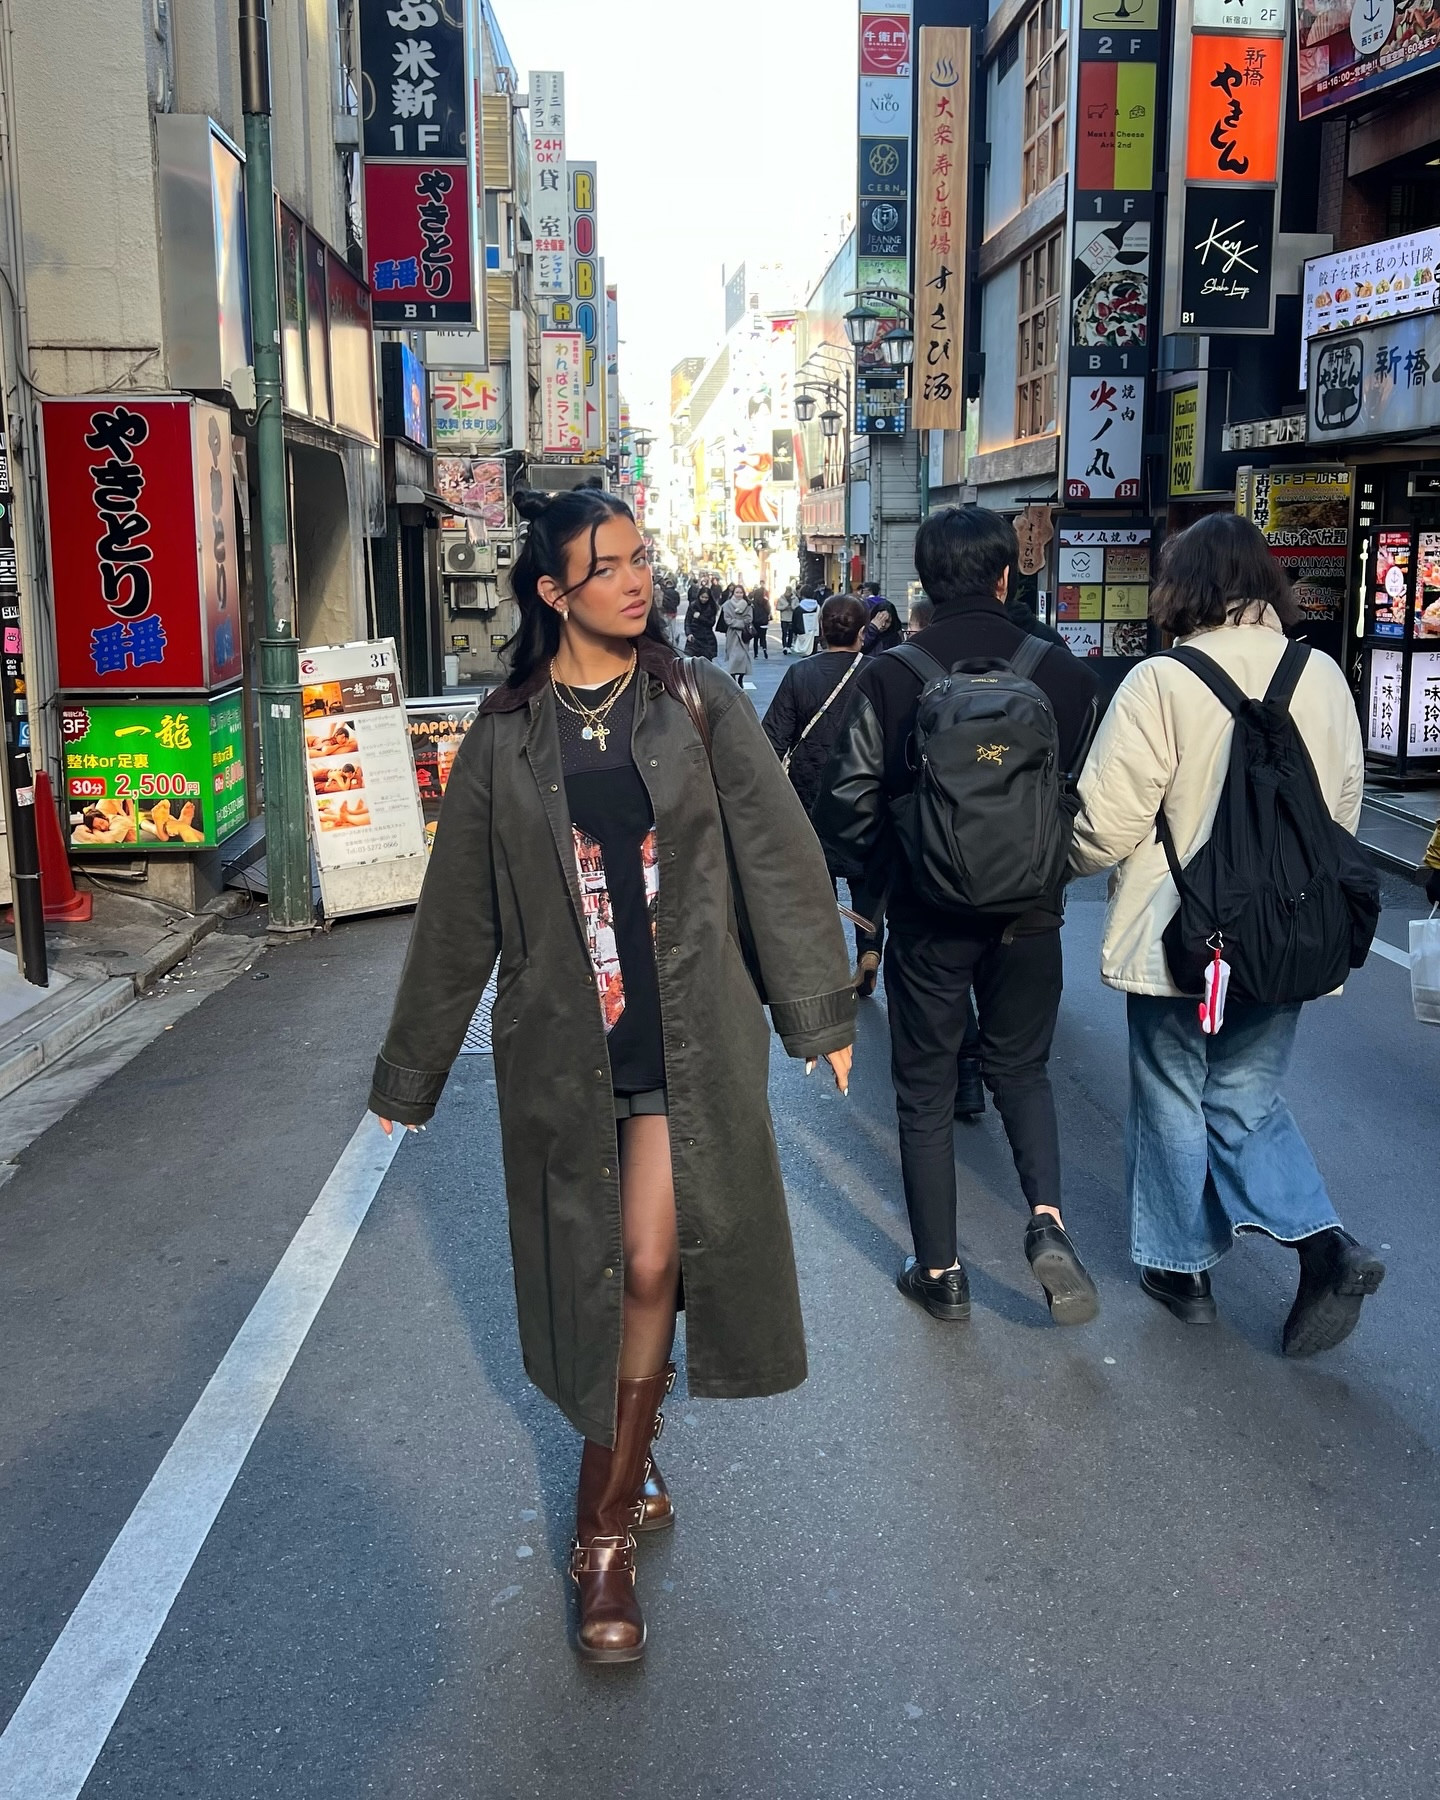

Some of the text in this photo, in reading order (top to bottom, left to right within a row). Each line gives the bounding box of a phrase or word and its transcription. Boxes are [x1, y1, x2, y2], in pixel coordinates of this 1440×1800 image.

[1222, 16, 1251, 24] (新宿店)
[1261, 9, 1277, 20] 2F
[864, 31, 906, 43] 牛衛門
[1243, 47, 1266, 87] 新橋
[870, 96, 900, 112] Nico
[534, 97, 544, 128] テラコ
[1210, 62, 1249, 175] やきとん
[389, 124, 441, 151] 1F
[534, 138, 562, 151] 24H
[537, 153, 561, 164] OK!
[930, 96, 954, 256] 大衆寿し酒場
[867, 184, 900, 192] CERN
[416, 169, 454, 298] やきとり
[867, 234, 902, 244] JEANNE
[1195, 217, 1259, 274] Key
[404, 304, 437, 319] B1
[1182, 313, 1194, 323] B1
[924, 265, 954, 401] すさび湯
[1374, 345, 1430, 389] 新橋
[434, 385, 500, 411] ランド
[863, 402, 900, 417] TOKYO
[1176, 401, 1197, 416] Italian
[1086, 380, 1118, 479] 火ノ丸
[1175, 424, 1194, 441] BOTTLE
[1175, 441, 1192, 457] WINE
[1173, 461, 1191, 486] 1900
[1273, 472, 1350, 485] 5F ゴールド館
[1069, 483, 1138, 496] 6F B1
[84, 405, 154, 618] やきとり
[1267, 528, 1347, 546] もんじゃ食べ放題
[370, 652, 390, 668] 3F
[1386, 652, 1394, 660] 2F
[1381, 675, 1394, 741] 一味玲玲
[63, 719, 85, 733] 3F
[408, 720, 459, 735] HAPPY
[67, 754, 149, 769] 整体or足裏
[72, 774, 200, 799] 30分 2,500円
